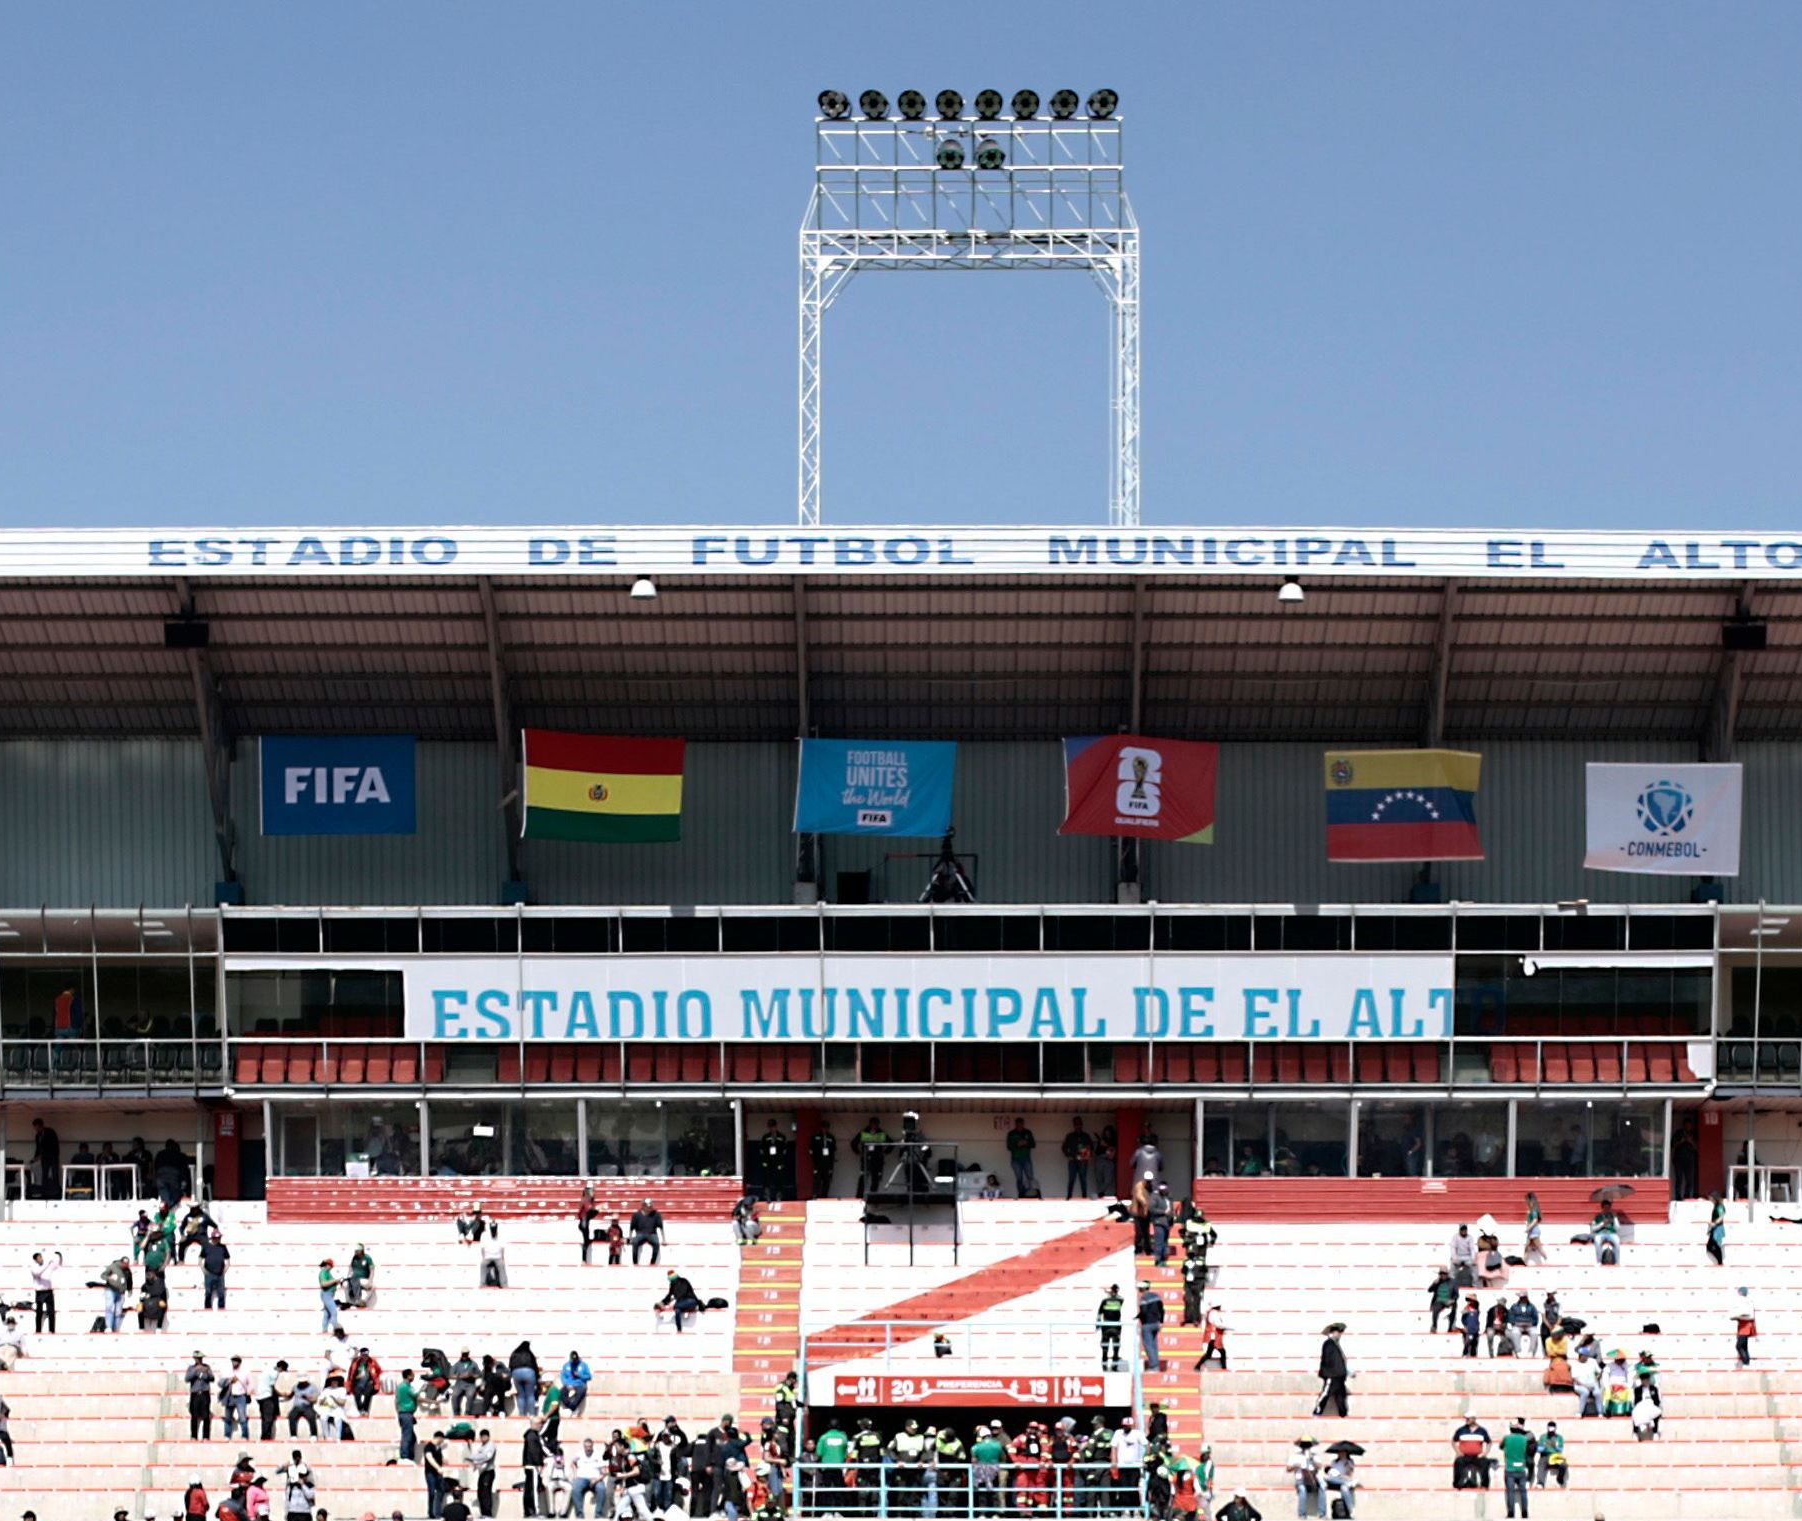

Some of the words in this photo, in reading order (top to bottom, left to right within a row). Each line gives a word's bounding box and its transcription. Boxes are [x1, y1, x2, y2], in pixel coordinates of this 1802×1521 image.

[149, 536, 458, 567] ESTADIO
[529, 536, 615, 567] DE
[692, 536, 974, 567] FUTBOL
[1048, 536, 1416, 567] MUNICIPAL
[1486, 539, 1565, 568] EL
[846, 750, 908, 766] FOOTBALL
[285, 767, 390, 803] FIFA
[846, 767, 908, 788] UNITES
[841, 788, 866, 805] the
[866, 788, 911, 807] World
[1129, 801, 1148, 810] FIFA
[861, 813, 887, 823] FIFA
[432, 988, 713, 1038] ESTADIO
[741, 987, 1107, 1038] MUNICIPAL
[1133, 986, 1215, 1038] DE
[1243, 987, 1321, 1038] EL
[1345, 987, 1454, 1038] ALT
[891, 1379, 914, 1395] 20
[1029, 1379, 1048, 1395] 19
